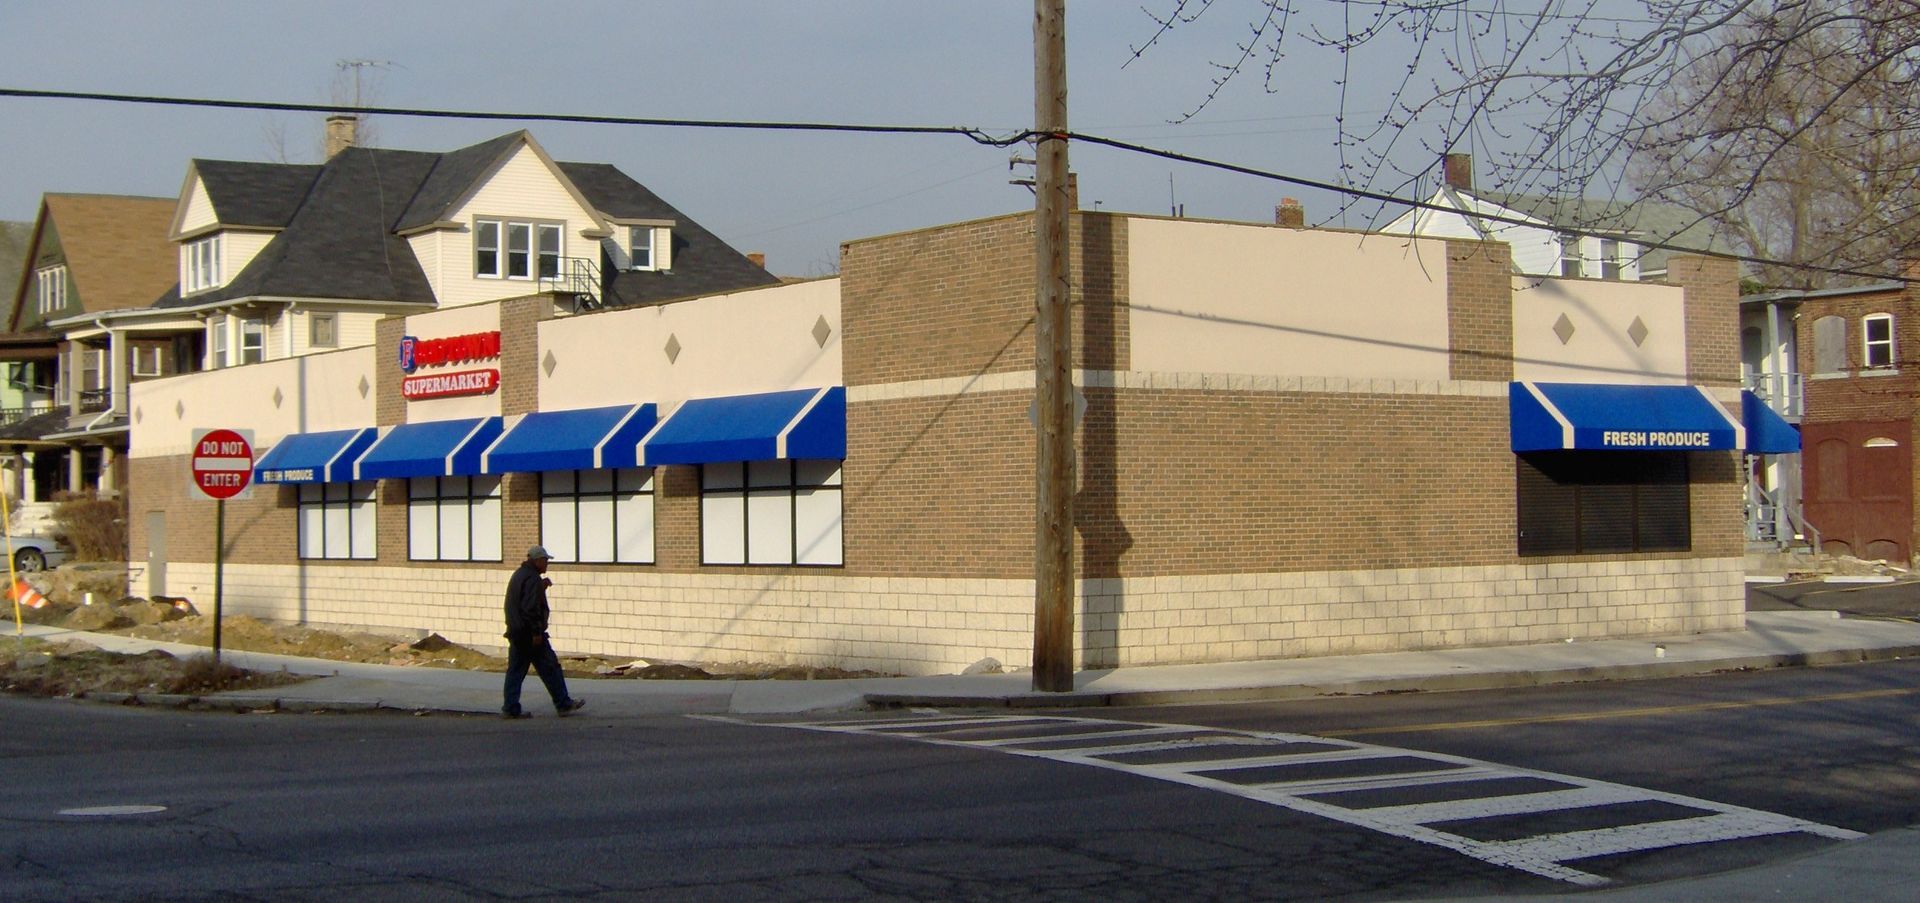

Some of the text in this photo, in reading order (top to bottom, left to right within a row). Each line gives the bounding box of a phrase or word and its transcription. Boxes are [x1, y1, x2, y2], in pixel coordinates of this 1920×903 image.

[404, 372, 491, 396] SUPERMARKET
[1603, 431, 1709, 446] FRESH PRODUCE
[203, 441, 244, 455] DO NOT
[203, 473, 241, 487] ENTER
[284, 469, 313, 481] PRODUCE
